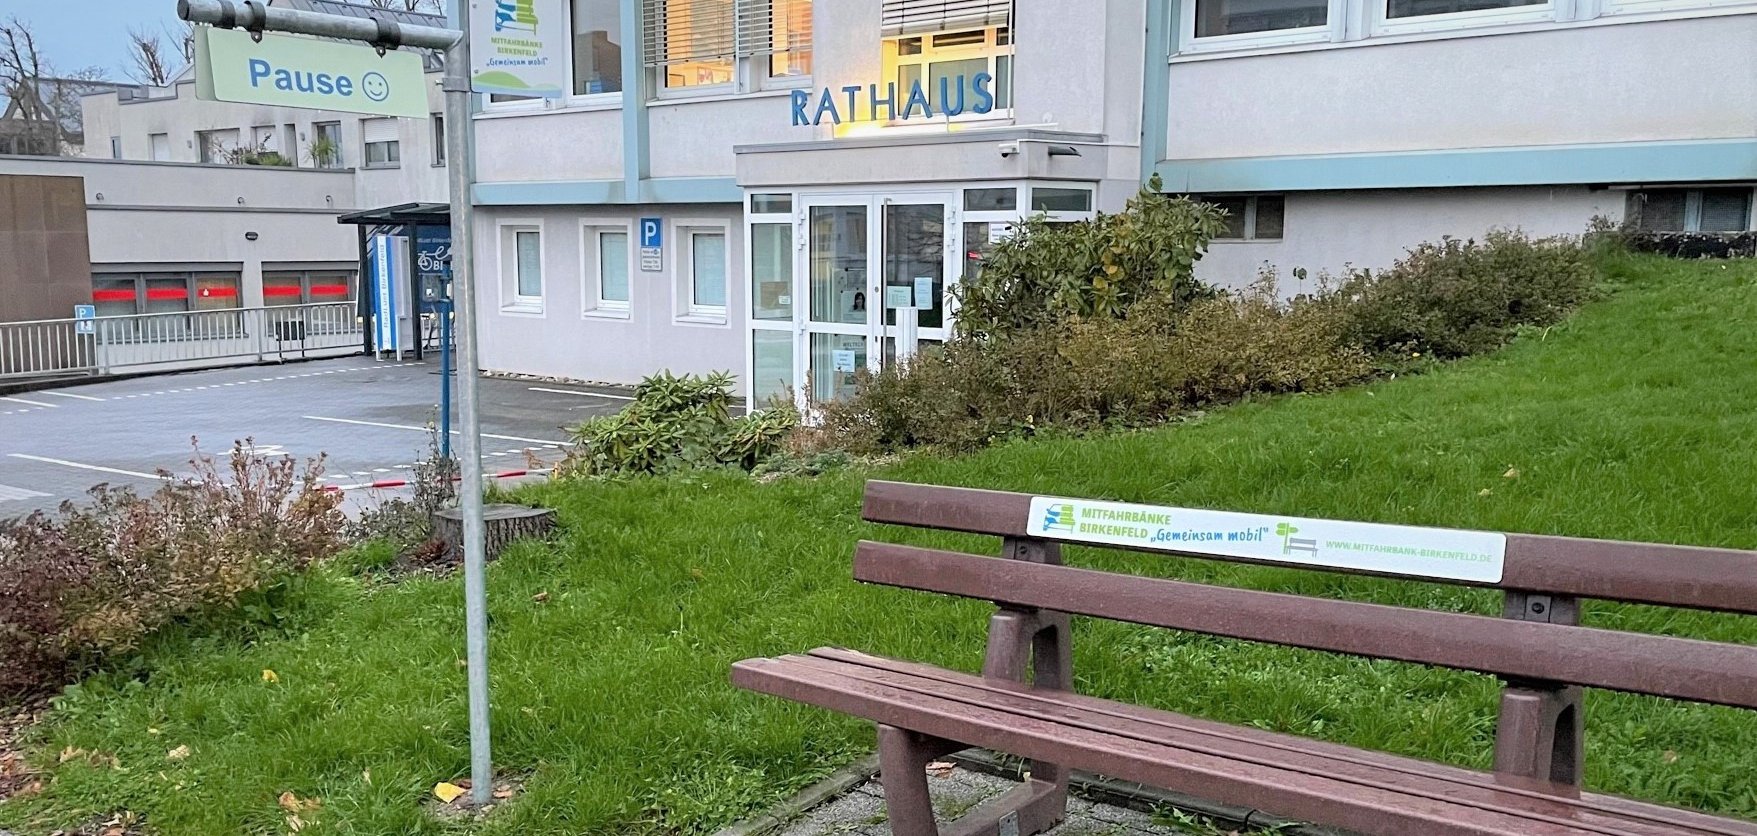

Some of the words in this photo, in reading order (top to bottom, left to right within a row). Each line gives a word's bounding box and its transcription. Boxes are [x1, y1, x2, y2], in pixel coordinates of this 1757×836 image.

[490, 37, 543, 48] MITFAHRBÄNKE
[497, 47, 538, 57] BIRKENFELD
[249, 58, 353, 97] Pause
[791, 72, 994, 127] RATHAUS
[645, 221, 657, 246] P
[79, 307, 87, 319] P
[1081, 507, 1171, 526] MITFAHRBÄNKE
[1079, 522, 1149, 539] BIRKENFELD
[1325, 540, 1493, 563] WWW.MITFAHRBANK-BIRKENFELD.DE
